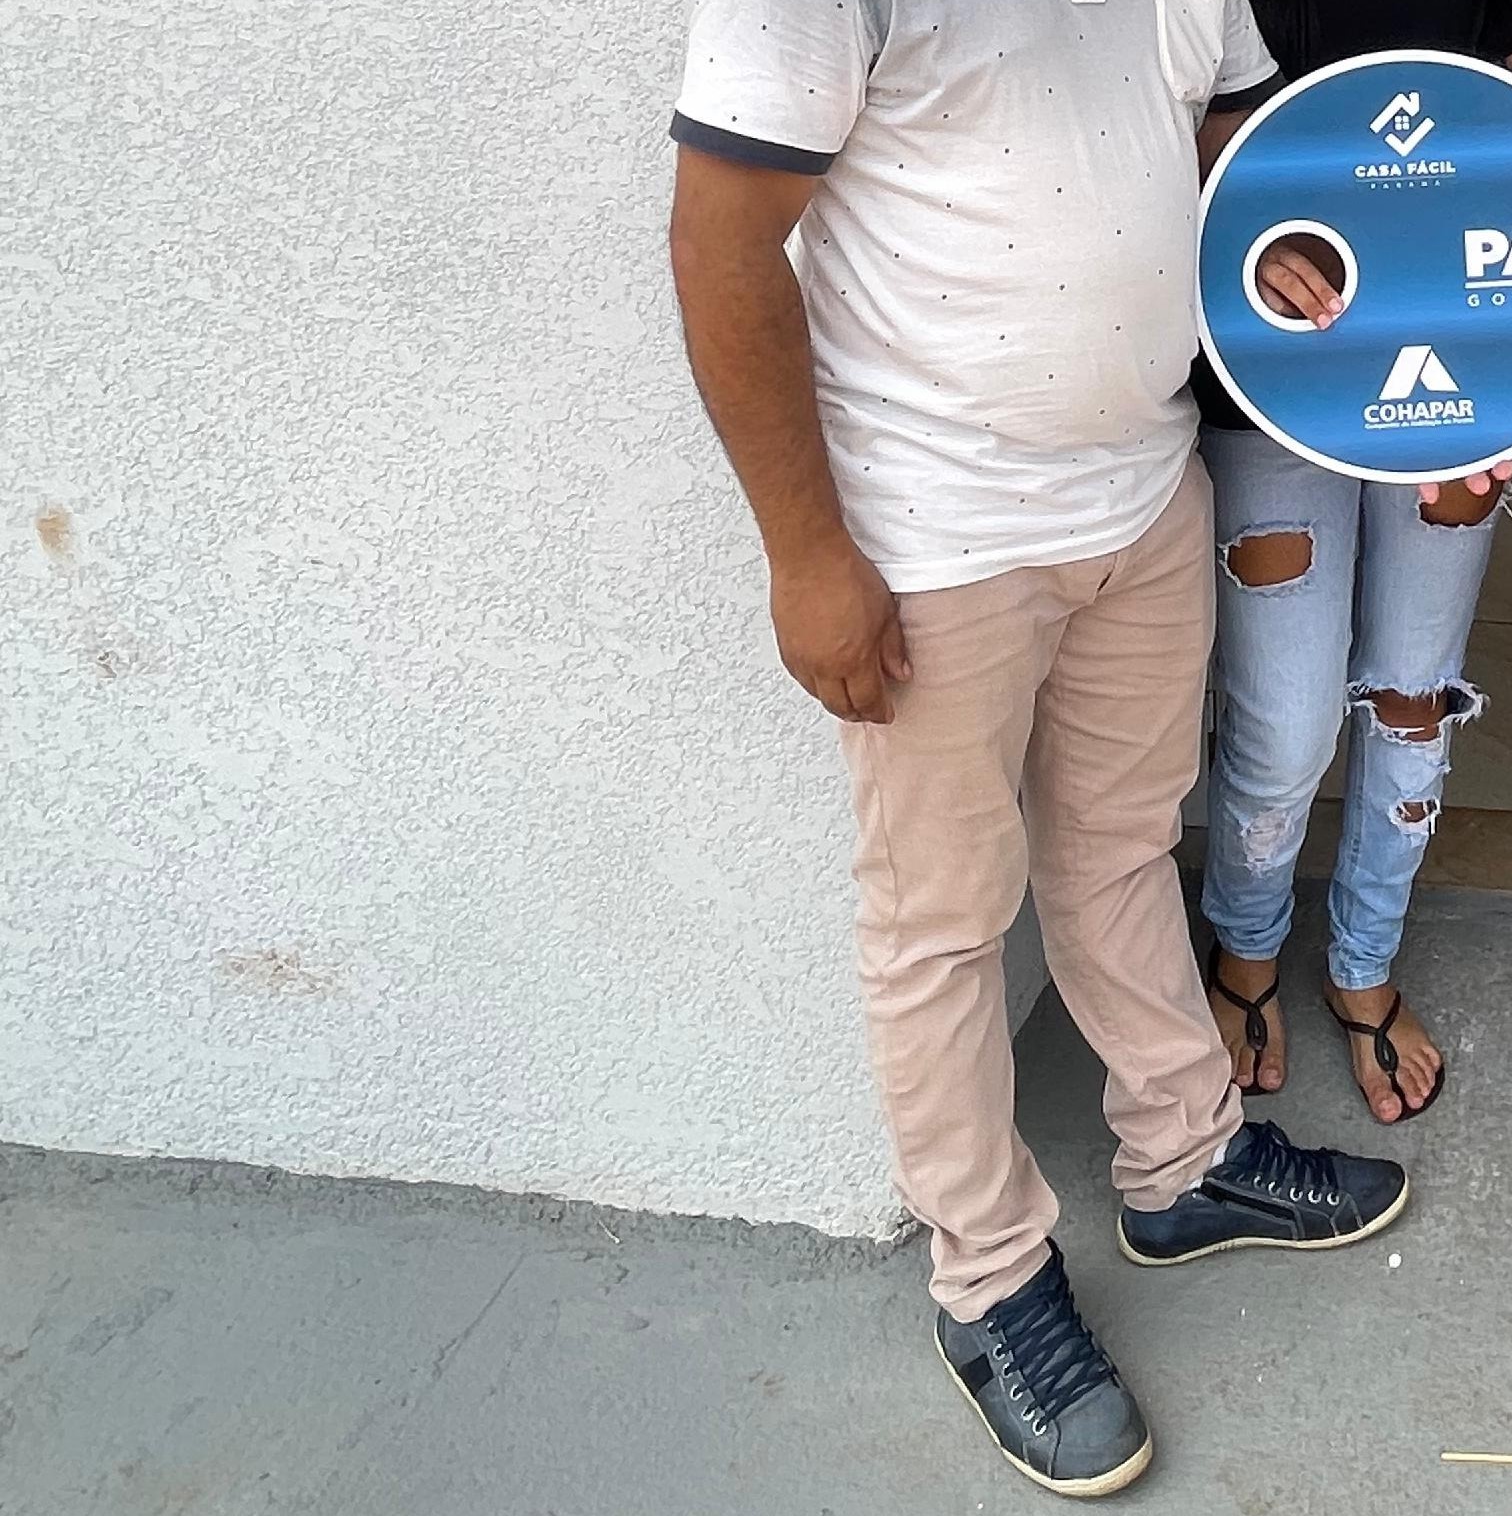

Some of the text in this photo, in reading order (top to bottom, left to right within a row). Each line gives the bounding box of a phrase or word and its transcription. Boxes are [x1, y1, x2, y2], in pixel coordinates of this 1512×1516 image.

[1354, 160, 1456, 178] CASA FÁCIL
[1364, 399, 1474, 423] COHAPAR
